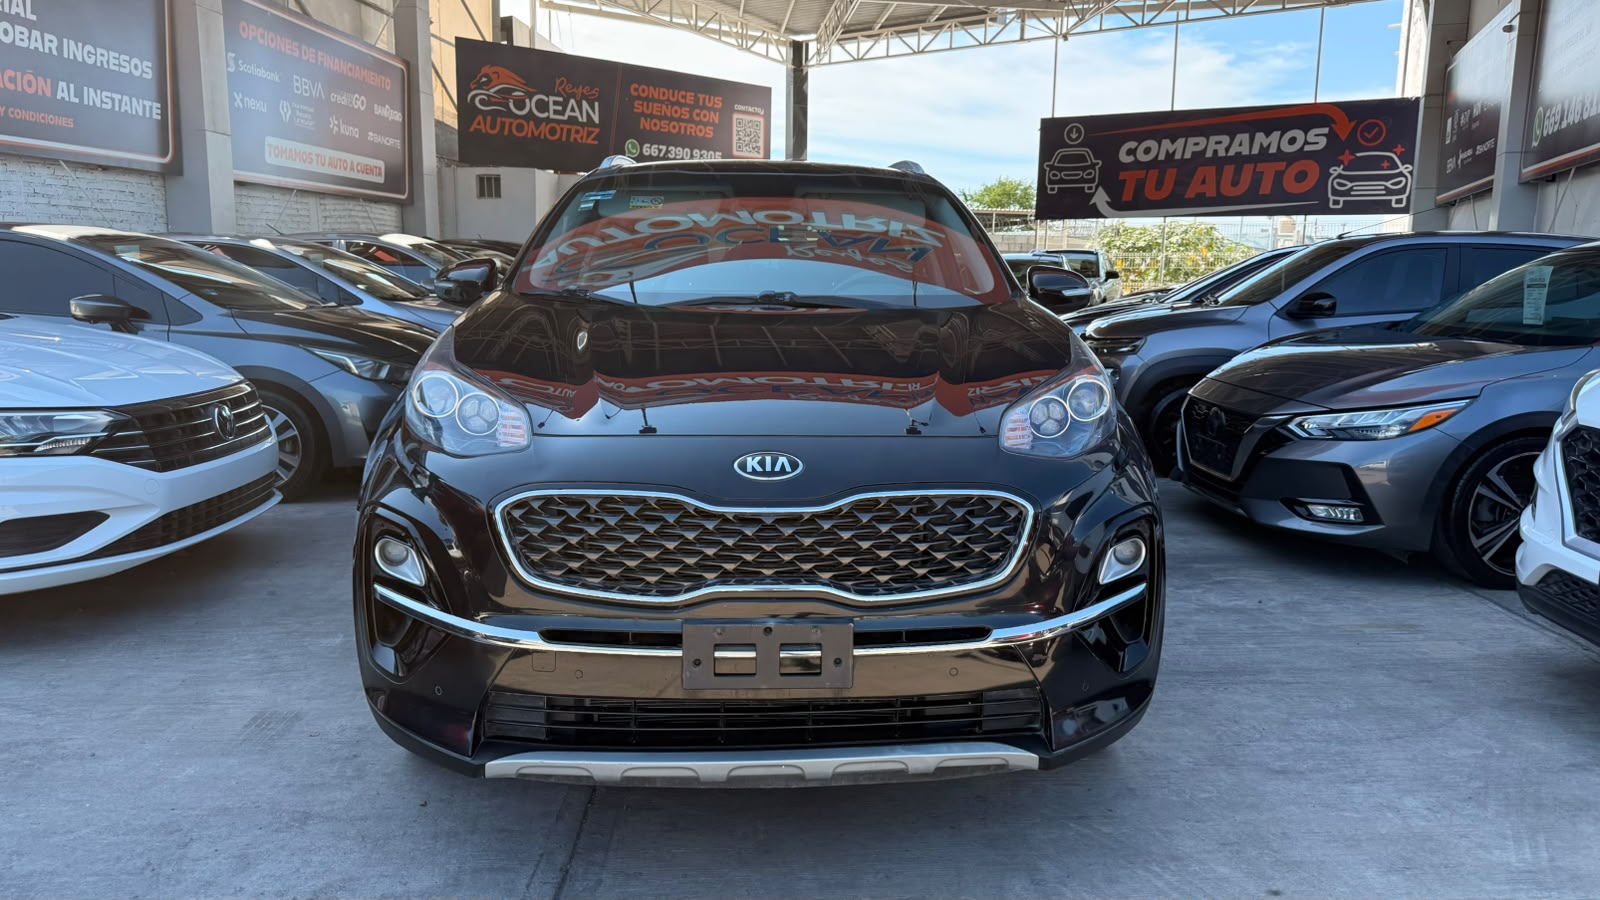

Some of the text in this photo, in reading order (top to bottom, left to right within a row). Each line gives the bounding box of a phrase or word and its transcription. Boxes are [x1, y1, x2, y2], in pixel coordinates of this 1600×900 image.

[63, 38, 153, 80] INGRESOS
[240, 21, 392, 91] OPCIONES DE FINANCIAMIENTO
[239, 60, 281, 82] Scotiabank
[0, 69, 162, 120] CIÓN AL INSTANTE
[293, 75, 325, 99] BBVA
[555, 77, 600, 101] Reyes
[630, 83, 723, 109] CONDUCE TUS
[244, 97, 267, 113] nexu
[508, 94, 600, 124] OCEAN
[633, 100, 720, 124] SUEÑOS CON
[734, 104, 762, 115] CONTACTO
[8, 108, 74, 128] CONDICIONES
[340, 118, 359, 138] kuna
[469, 115, 600, 145] AUTOMOTRIZ
[640, 117, 715, 139] NOSOTROS
[1118, 127, 1330, 164] COMPRAMOS
[267, 143, 383, 178] TOMAMOS TU AUTO A CUENTA
[1118, 159, 1321, 203] TU AUTO
[746, 455, 792, 472] KIA
